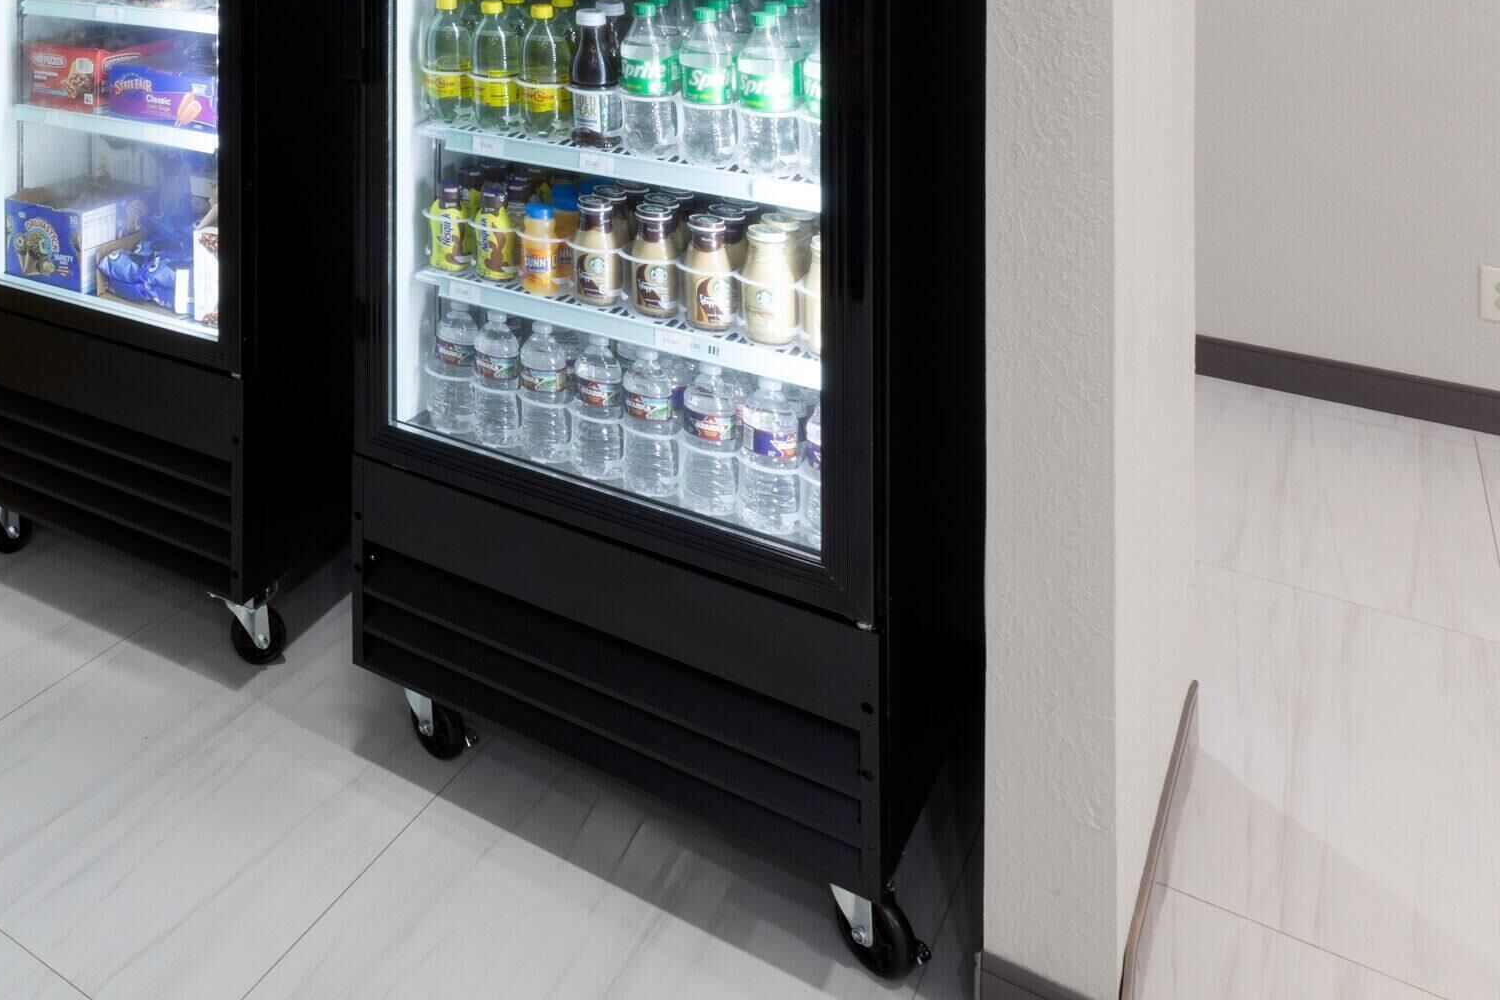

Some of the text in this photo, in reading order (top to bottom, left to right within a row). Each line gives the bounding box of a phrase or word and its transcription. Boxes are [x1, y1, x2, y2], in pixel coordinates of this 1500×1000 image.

[621, 60, 666, 83] Sprite
[435, 77, 454, 89] Chico
[688, 70, 730, 90] Sprit
[114, 78, 152, 95] STATE FAIR
[146, 94, 171, 106] Classic
[533, 90, 555, 102] Chico
[24, 216, 60, 253] DRUMSTICK
[441, 213, 453, 247] Nesquk
[53, 254, 73, 263] VARIETY
[580, 387, 608, 398] OZARKA
[695, 420, 726, 431] OZARKA
